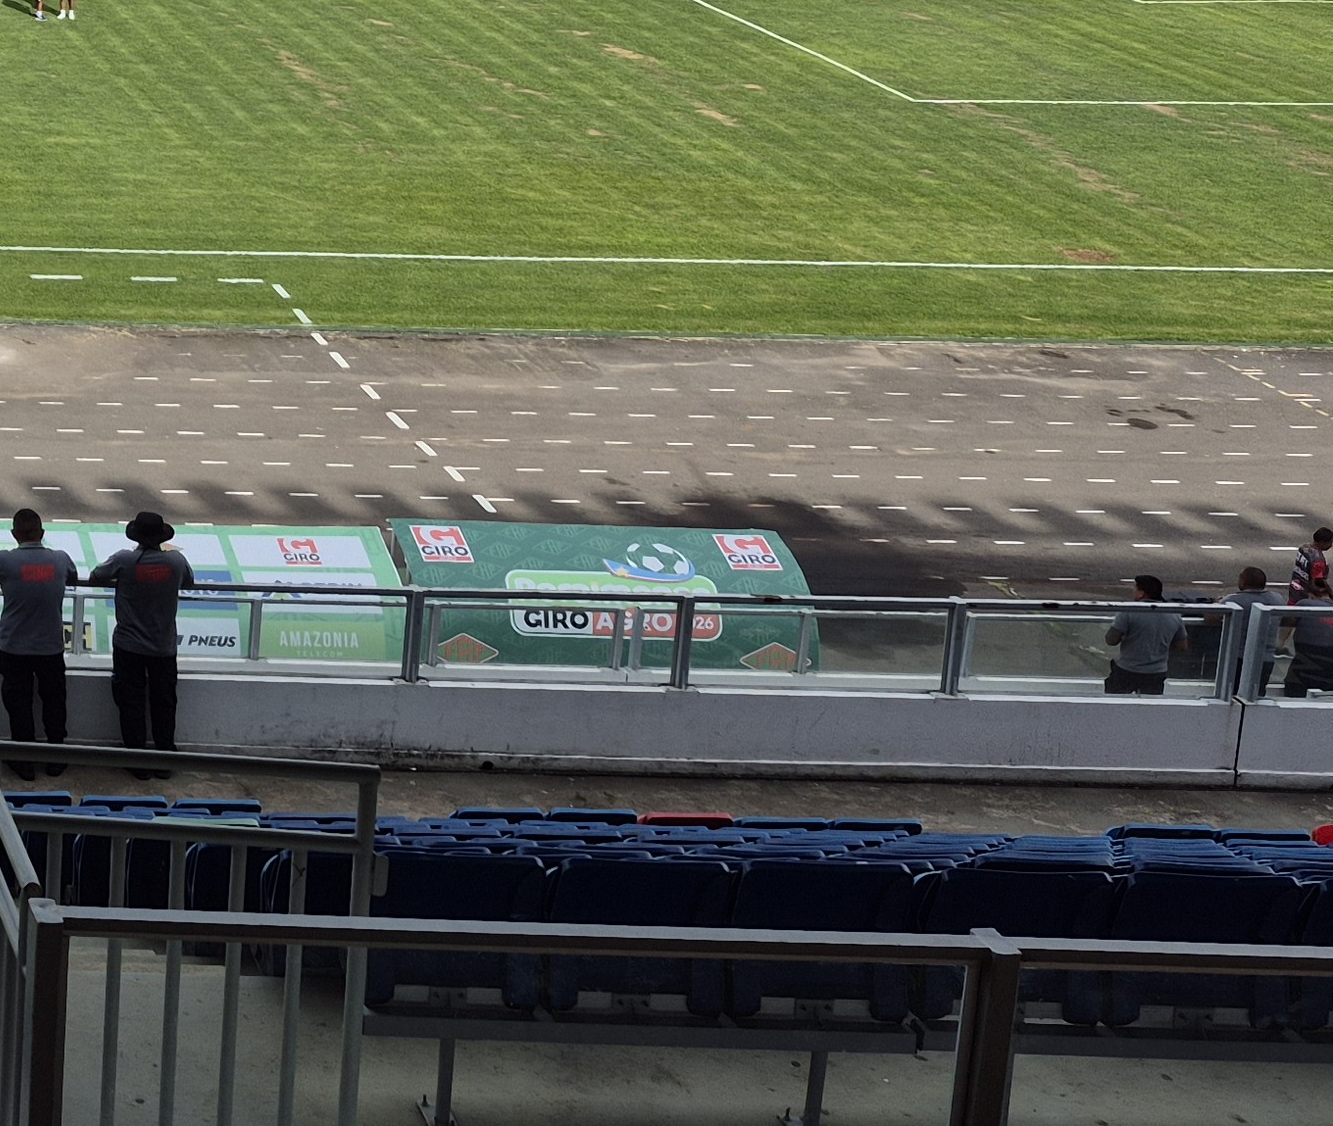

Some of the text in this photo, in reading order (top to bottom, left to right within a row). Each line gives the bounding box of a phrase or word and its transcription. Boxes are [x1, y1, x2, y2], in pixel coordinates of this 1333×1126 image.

[421, 545, 469, 556] GIRO
[283, 552, 320, 562] GIRO
[728, 554, 777, 564] GIRO
[523, 610, 589, 629] GIRO
[188, 634, 237, 648] PNEUS
[279, 630, 359, 649] AMAZONIA
